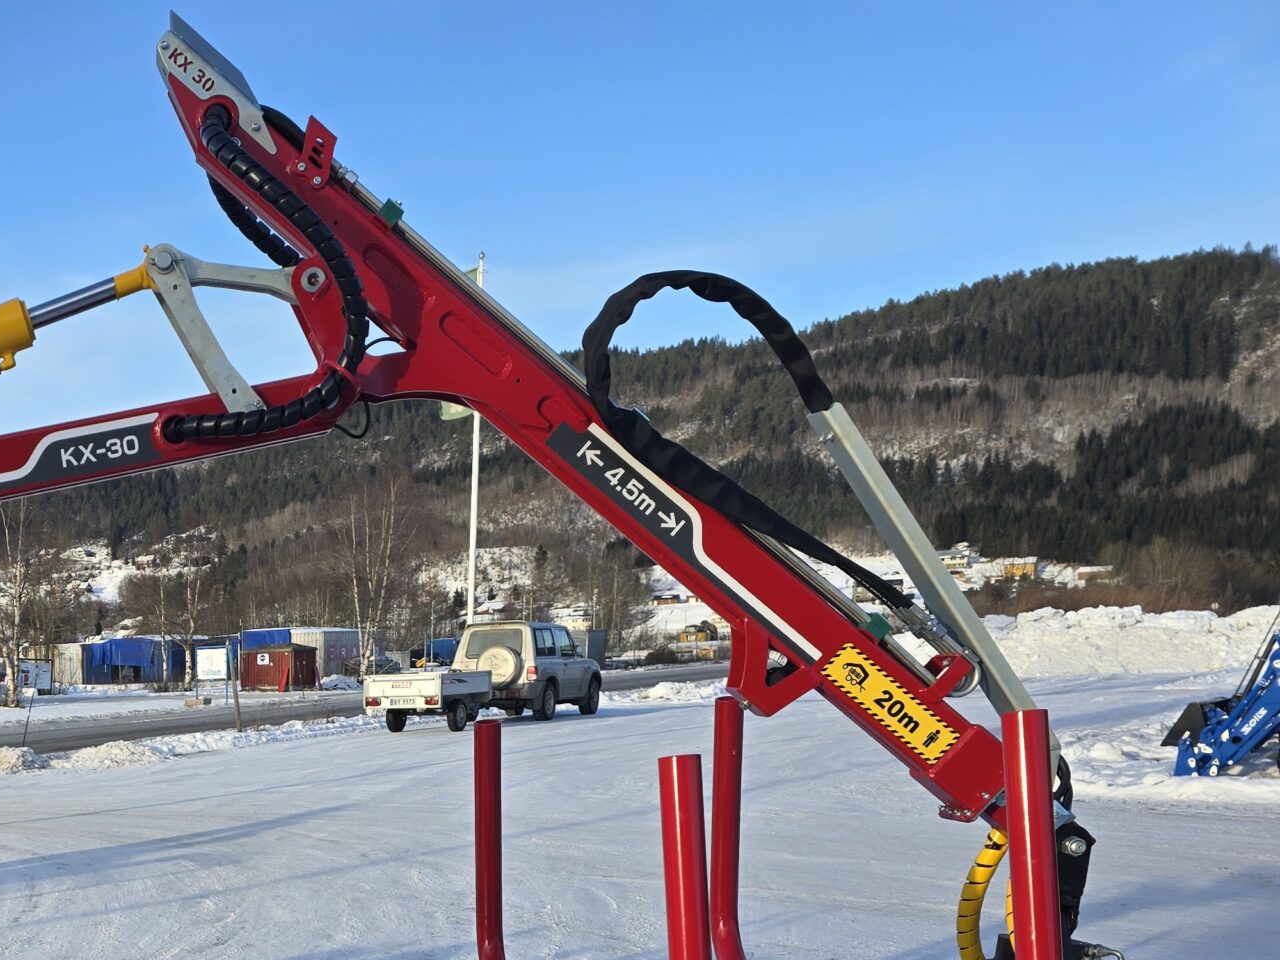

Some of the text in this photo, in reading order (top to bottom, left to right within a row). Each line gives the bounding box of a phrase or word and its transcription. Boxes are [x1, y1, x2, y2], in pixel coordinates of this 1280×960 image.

[168, 47, 215, 92] KX 30
[60, 434, 139, 468] KX-30
[604, 467, 656, 516] 4.5m
[873, 689, 920, 734] 20m
